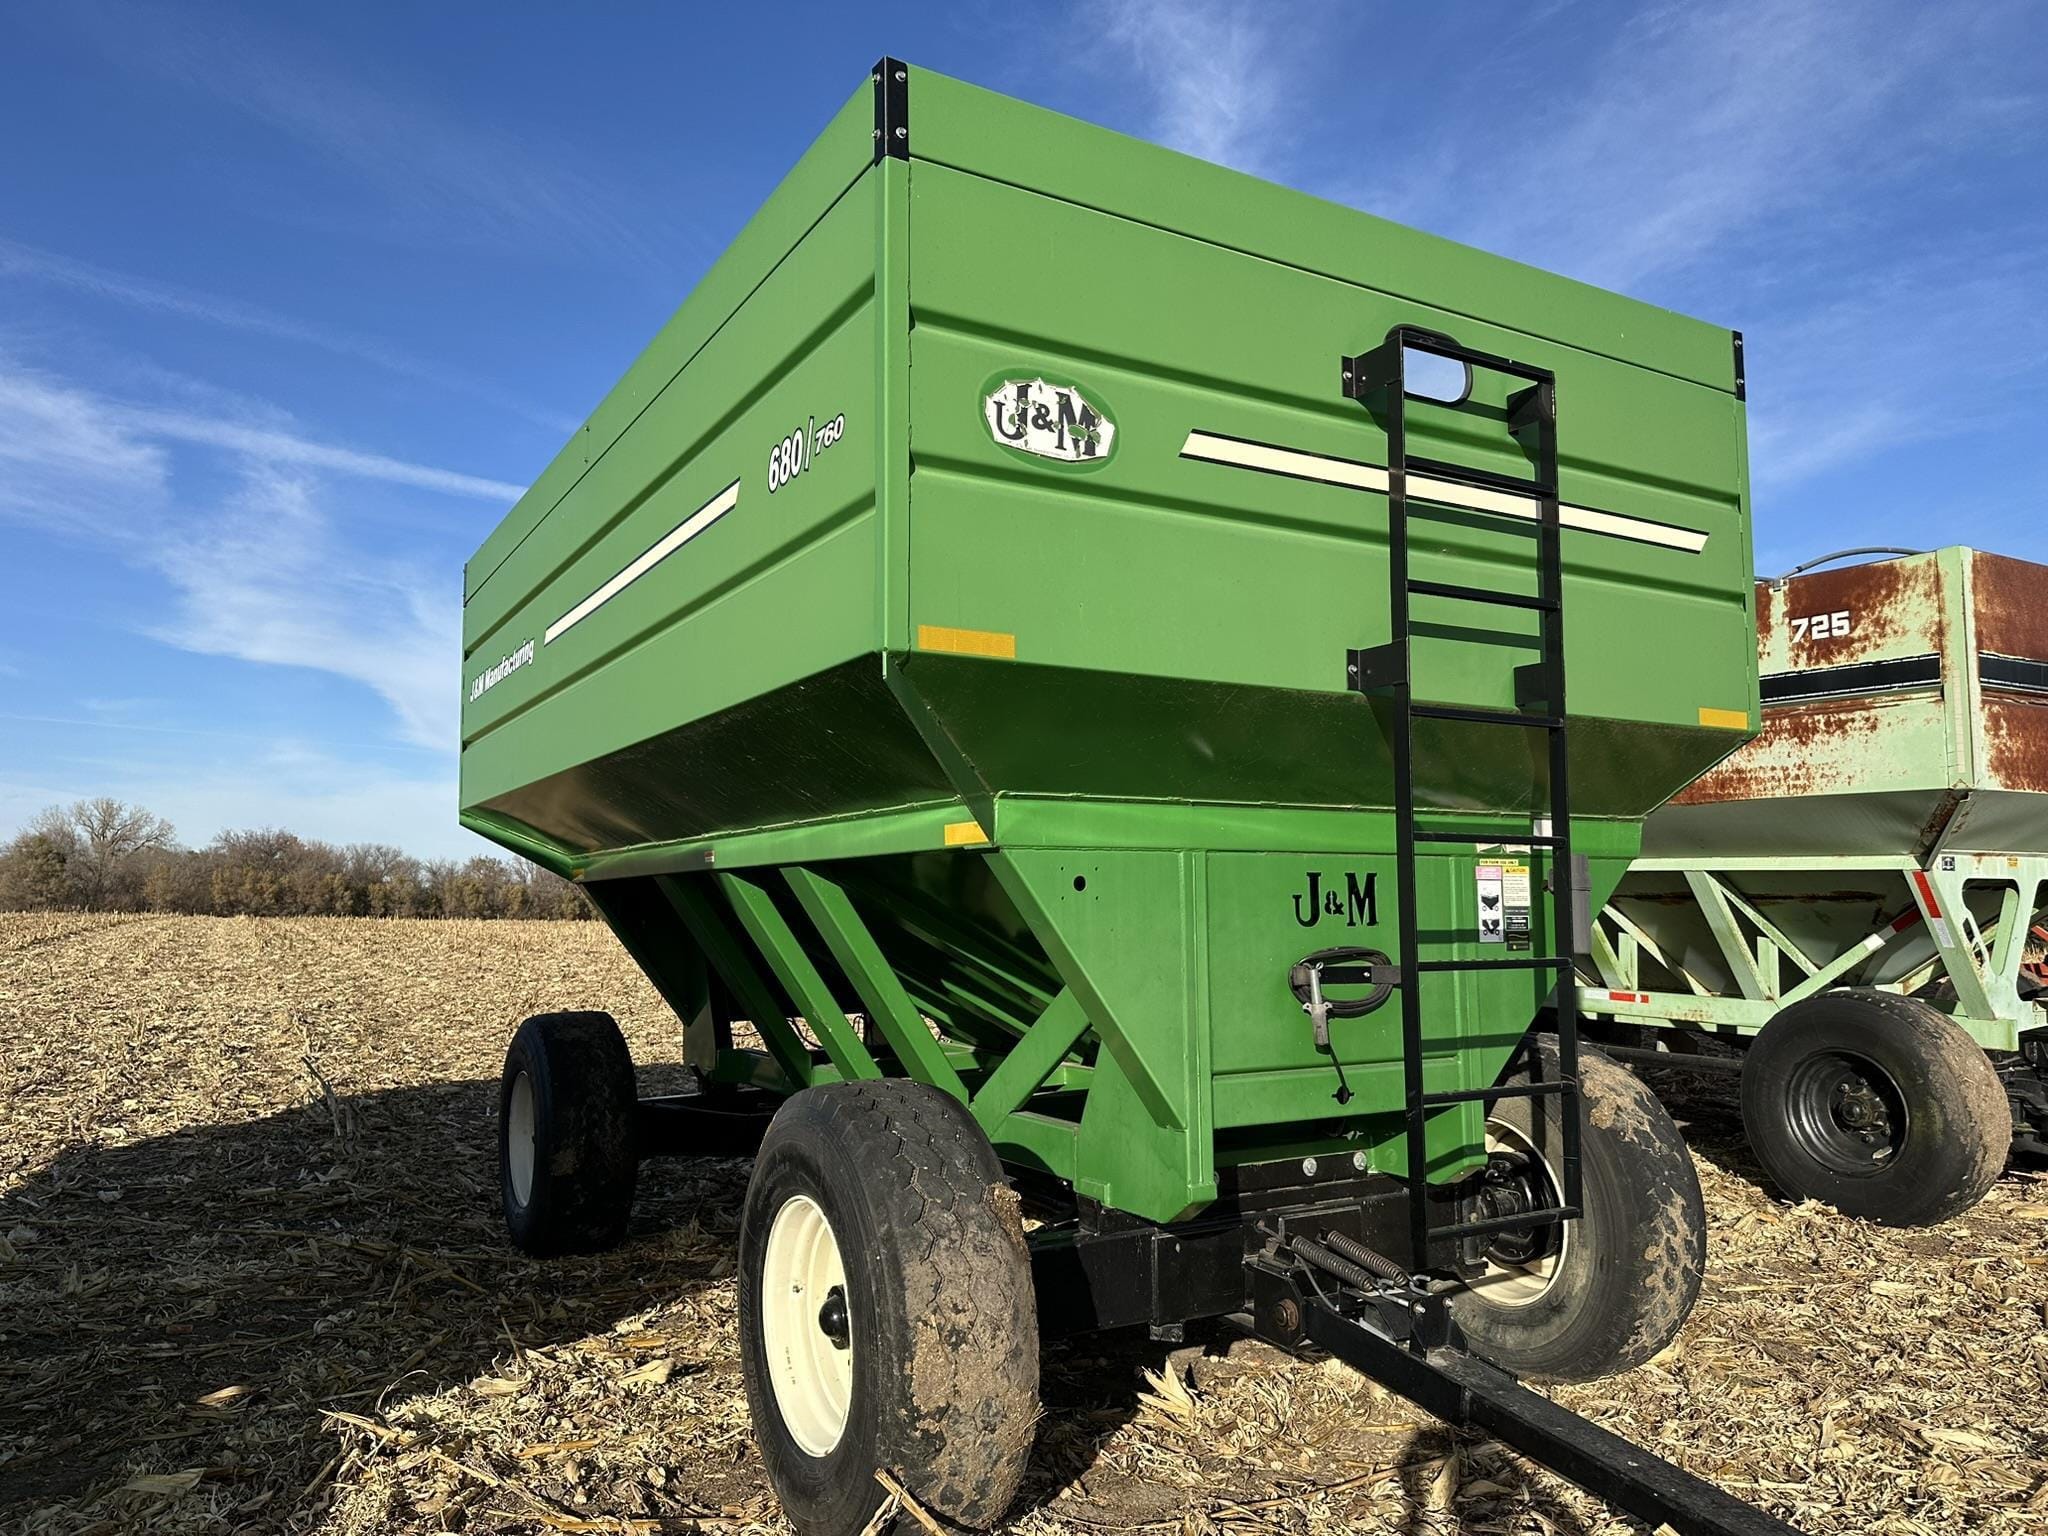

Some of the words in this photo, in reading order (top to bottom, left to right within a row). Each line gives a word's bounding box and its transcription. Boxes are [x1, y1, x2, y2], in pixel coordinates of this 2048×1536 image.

[993, 383, 1100, 456] J&M
[1790, 610, 1850, 643] 725
[470, 671, 485, 702] J&M
[484, 638, 535, 693] Manufacturing
[1292, 872, 1379, 928] J&M
